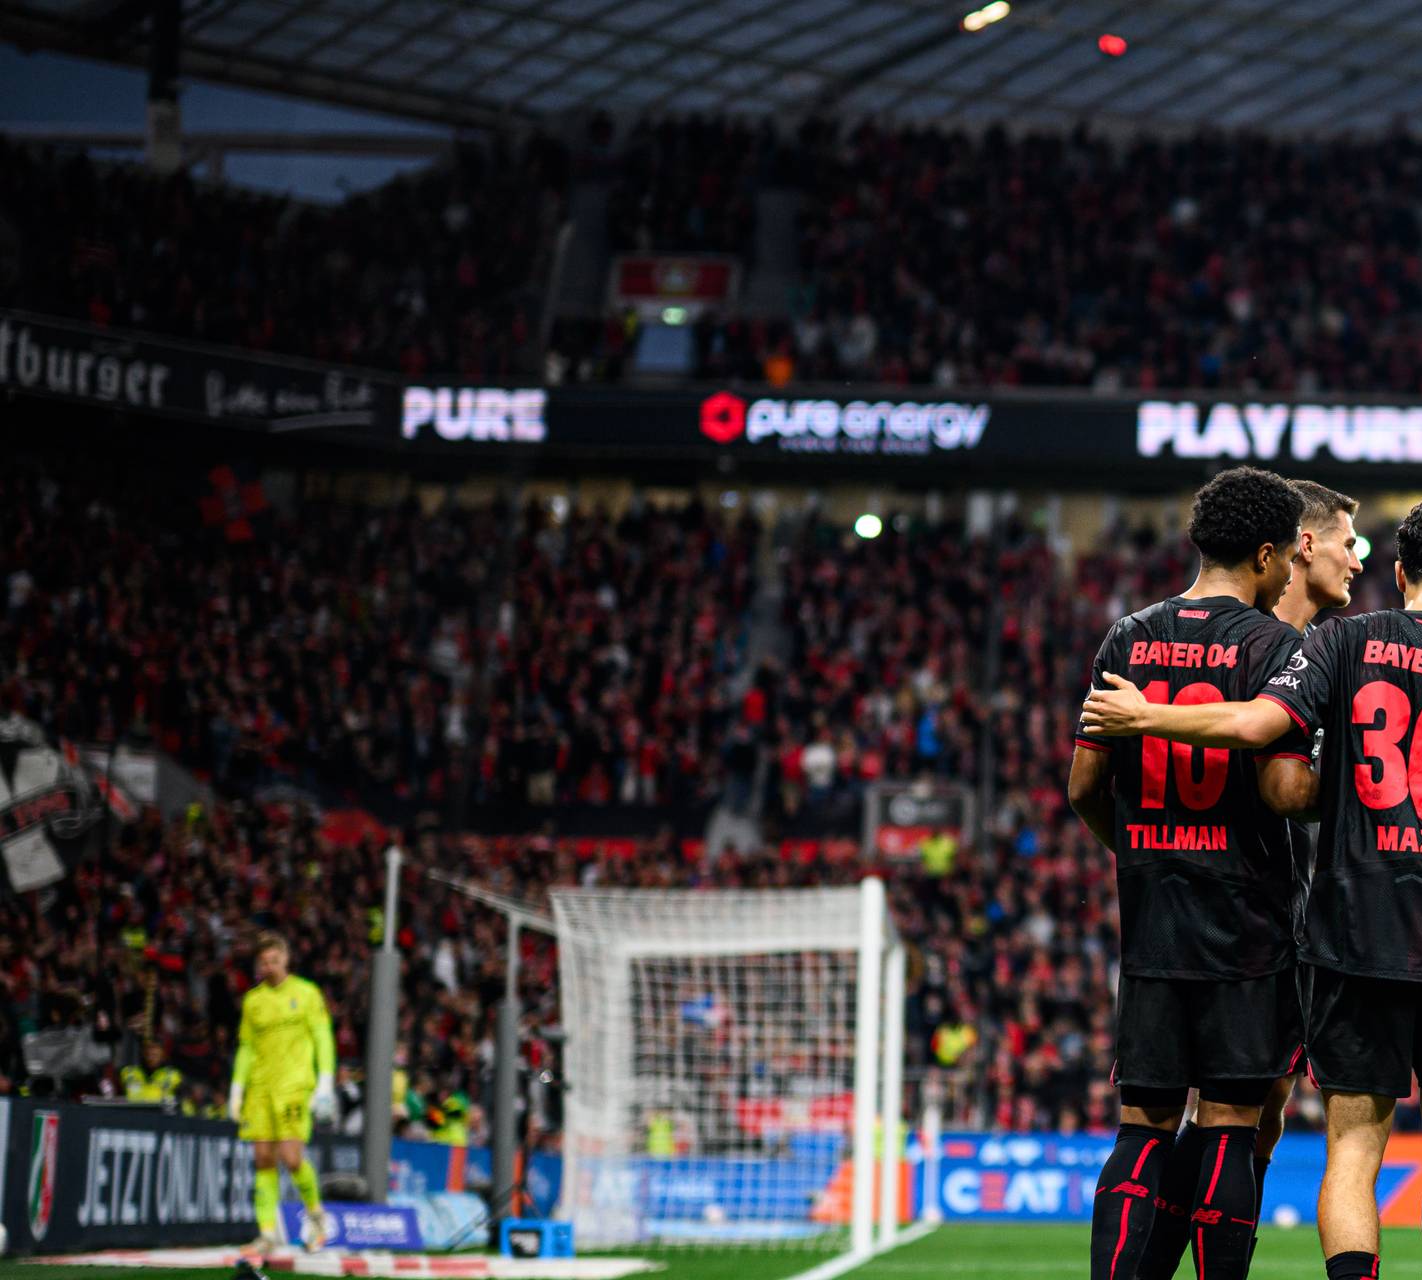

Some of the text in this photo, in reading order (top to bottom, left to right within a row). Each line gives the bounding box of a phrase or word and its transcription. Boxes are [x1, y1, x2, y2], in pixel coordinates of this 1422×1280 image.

[403, 386, 547, 441] PURE
[1137, 402, 1289, 459] PLAY
[1129, 641, 1238, 669] BAYER 04
[1141, 680, 1229, 811] 10
[1127, 824, 1227, 851] TILLMAN
[78, 1127, 155, 1227] JETZT
[157, 1131, 230, 1225] ONLINE
[942, 1167, 1068, 1217] CEAT
